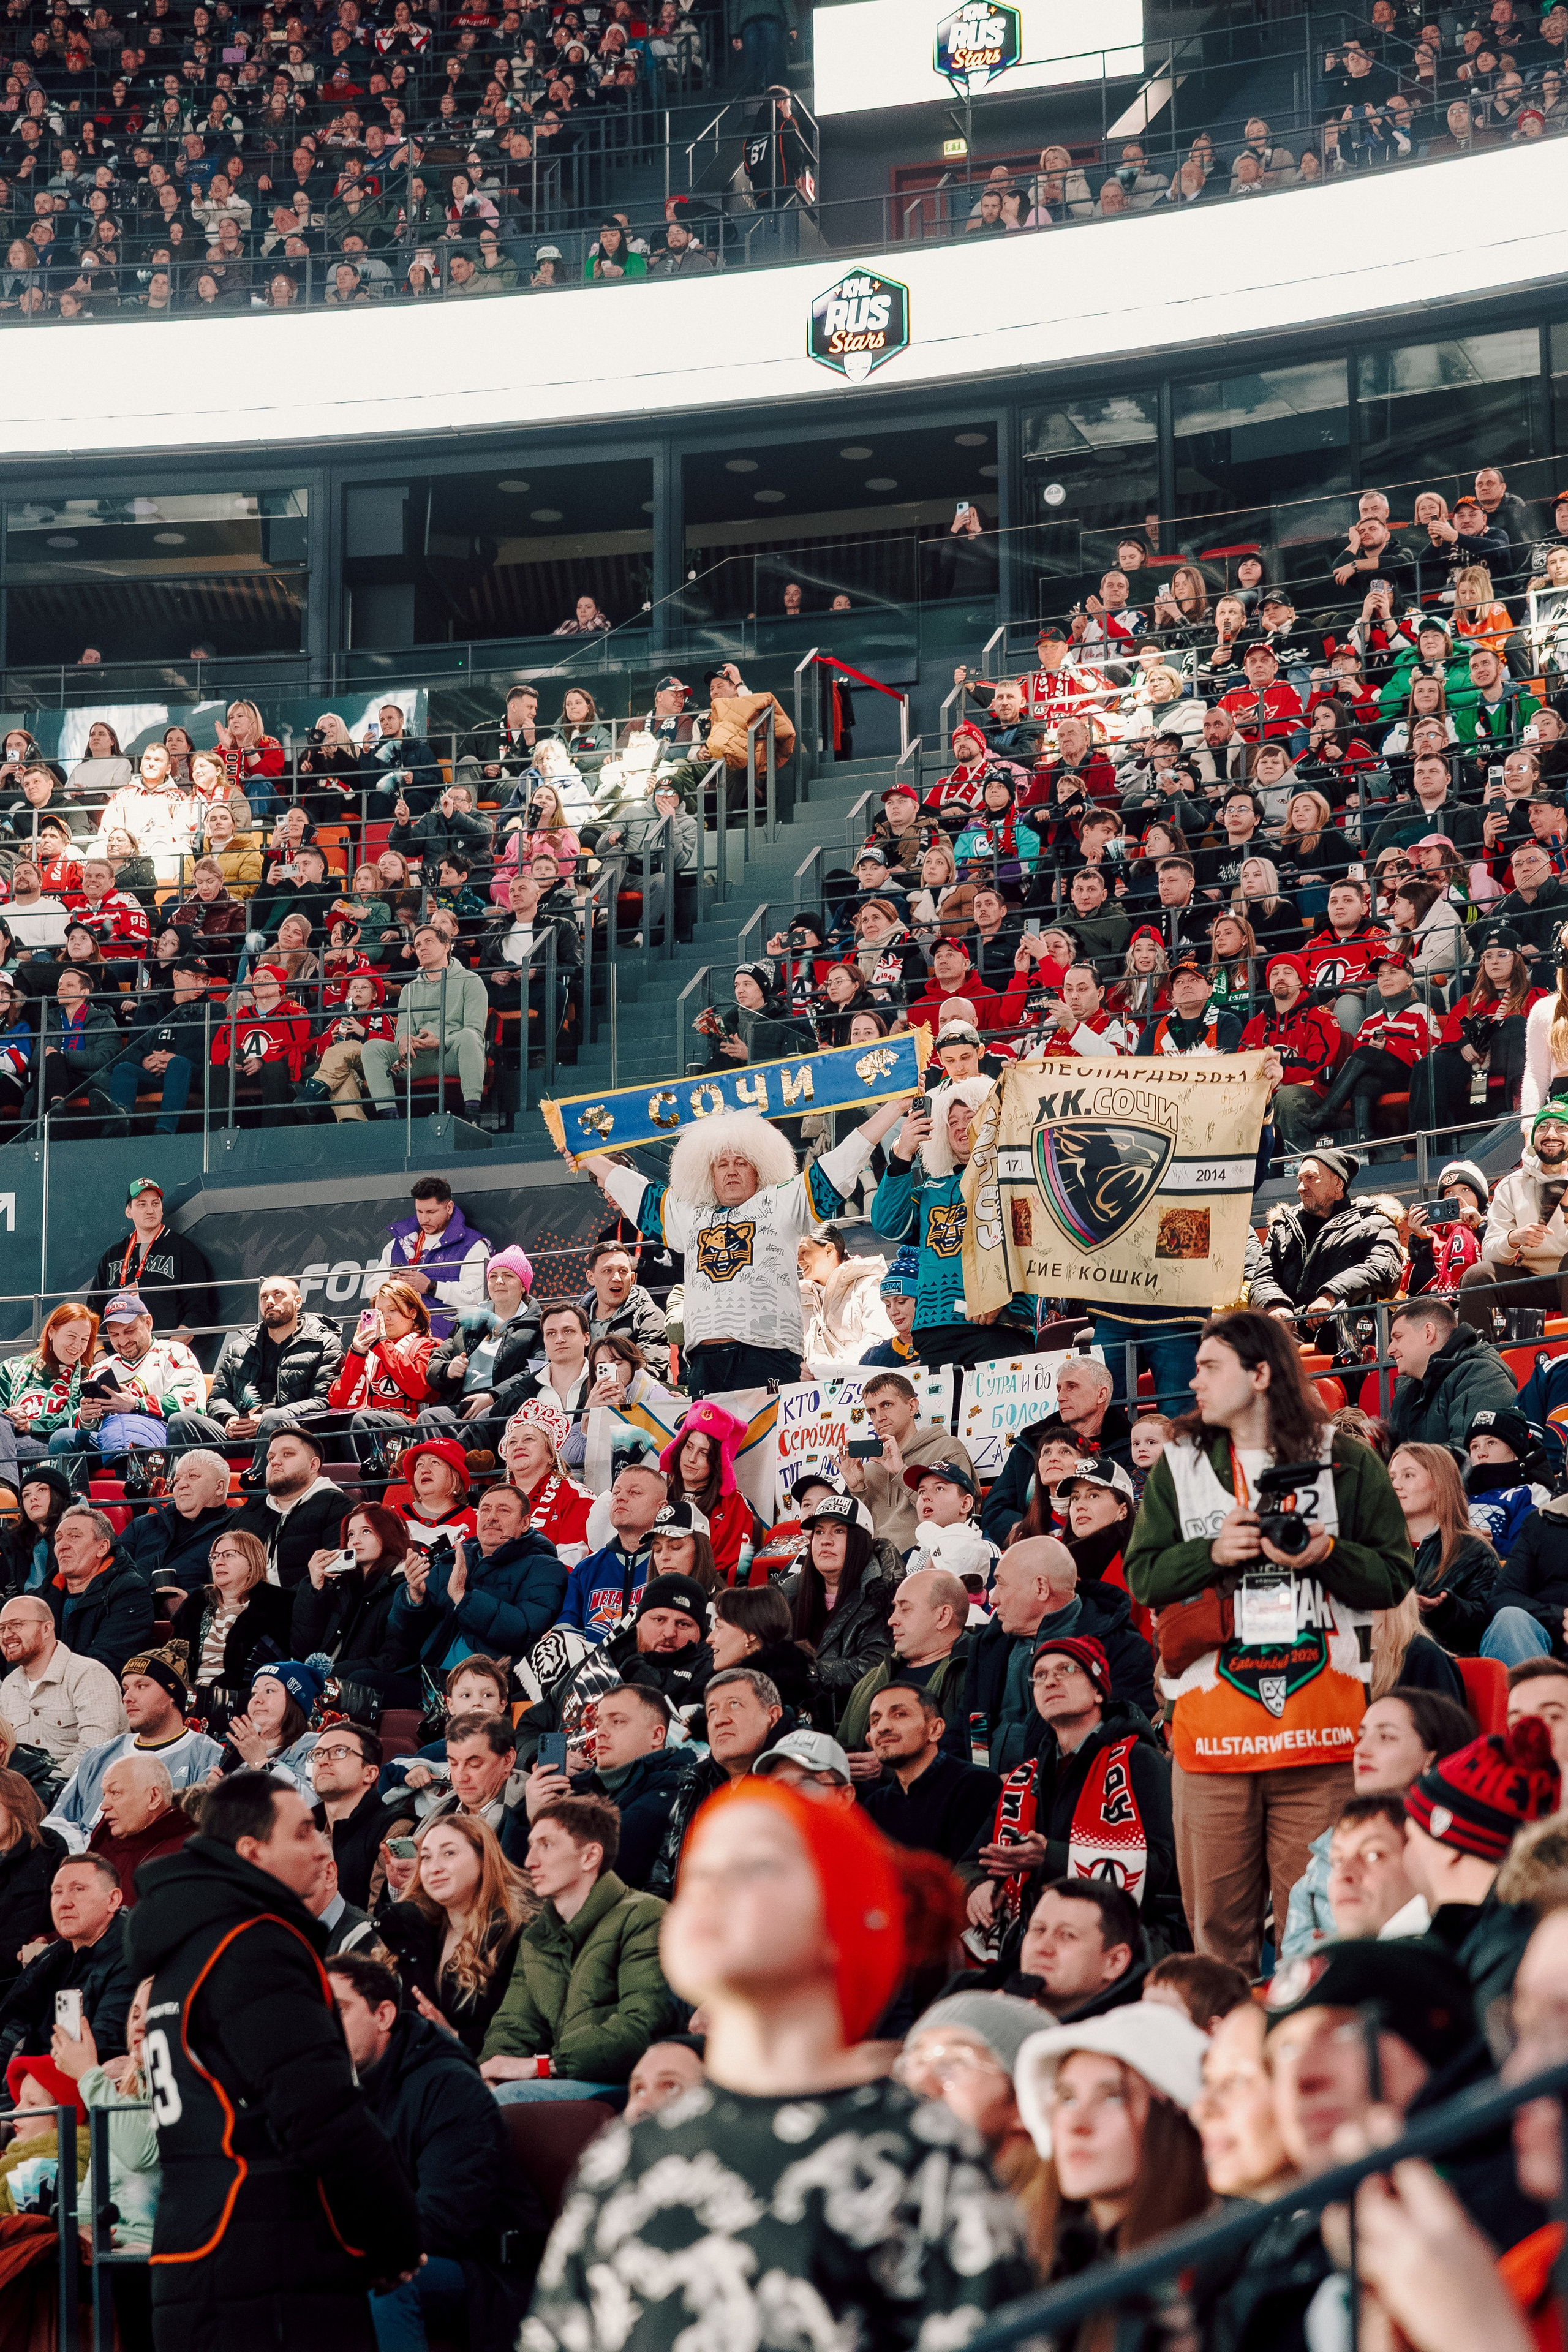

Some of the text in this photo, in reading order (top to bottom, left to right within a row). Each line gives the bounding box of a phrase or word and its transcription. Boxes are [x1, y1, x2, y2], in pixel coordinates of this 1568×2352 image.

[962, 4, 990, 22] KHL
[948, 17, 1006, 54] RUS
[951, 48, 1001, 69] Stars
[750, 140, 768, 165] 67
[842, 277, 874, 299] KHL
[824, 295, 891, 336] RUS
[828, 330, 886, 353] Stars
[647, 1064, 815, 1129] СОЧИ
[1196, 1168, 1226, 1182] 2014
[1079, 1266, 1158, 1287] КОШКИ
[1539, 1355, 1545, 1364] 6
[783, 1390, 820, 1425] КТО
[992, 1400, 1059, 1430] БОЛЕЕ
[287, 1676, 303, 1695] 87
[1195, 1727, 1354, 1755] ALLSTARWEEK.COM
[142, 2029, 183, 2129] 3
